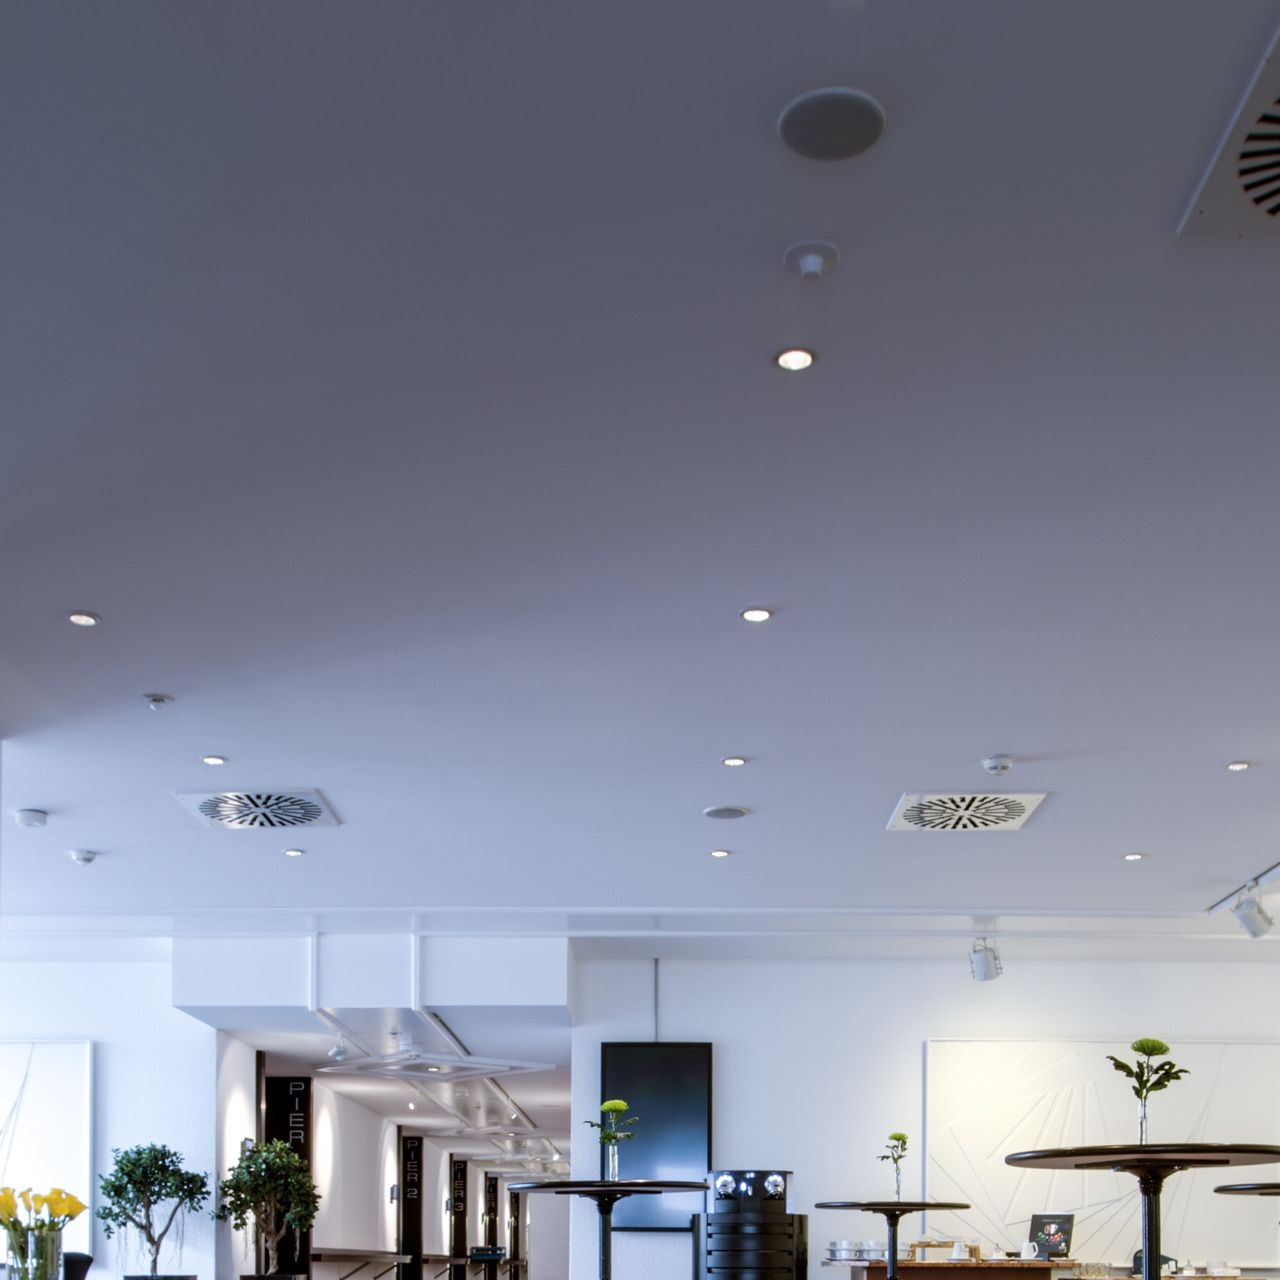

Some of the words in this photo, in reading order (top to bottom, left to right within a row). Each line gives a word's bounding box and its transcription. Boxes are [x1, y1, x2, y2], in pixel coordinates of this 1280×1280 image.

[289, 1081, 305, 1144] PIER
[407, 1140, 418, 1183] PIER
[407, 1187, 418, 1199] 2
[454, 1163, 464, 1199] PIER
[454, 1202, 464, 1212] 3
